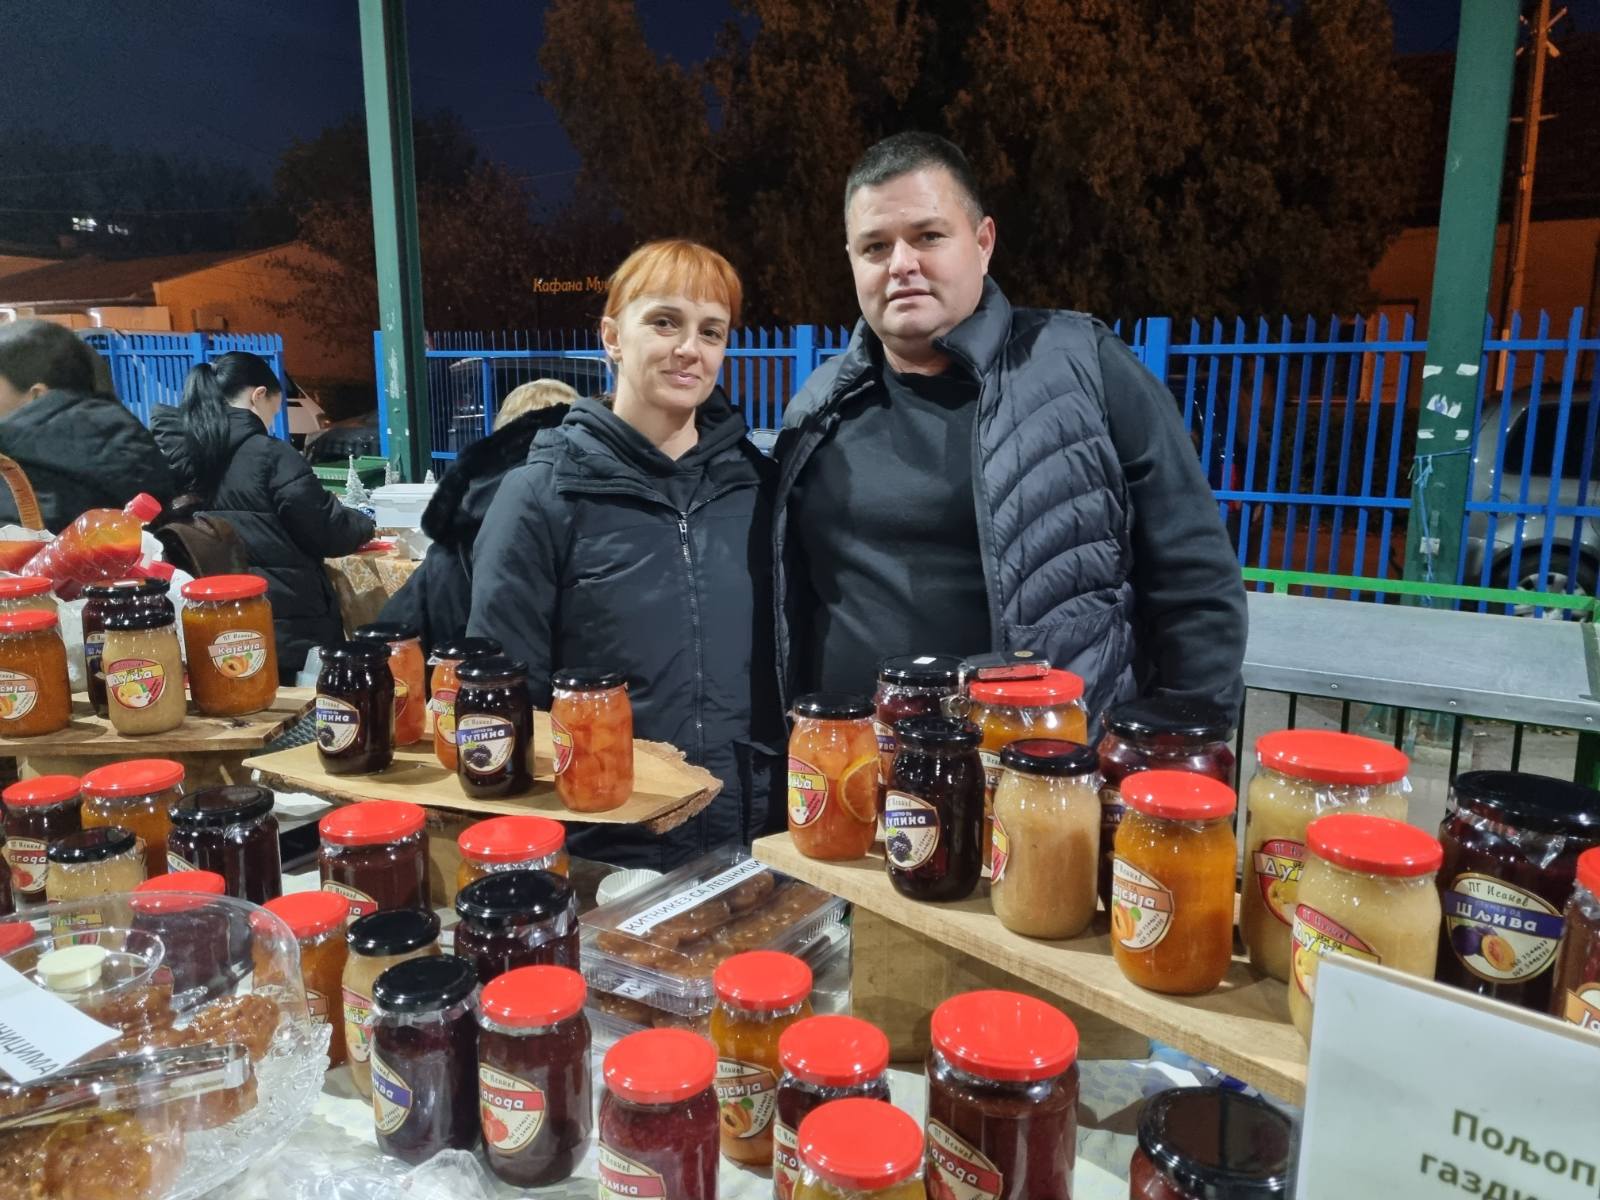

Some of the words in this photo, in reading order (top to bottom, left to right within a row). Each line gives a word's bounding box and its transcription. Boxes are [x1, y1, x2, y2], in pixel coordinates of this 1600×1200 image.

[532, 277, 583, 294] Кафана
[217, 643, 260, 656] Кајсија
[0, 683, 26, 694] сија
[460, 728, 505, 744] Купина
[10, 854, 47, 865] агода
[1112, 884, 1156, 908] ајсија
[1456, 901, 1538, 932] Шљива
[0, 1022, 60, 1076] НИЦИМА
[373, 1077, 395, 1100] ива
[717, 1083, 762, 1099] ајсија
[481, 1089, 524, 1111] агода
[1451, 1109, 1600, 1190] Пољоп
